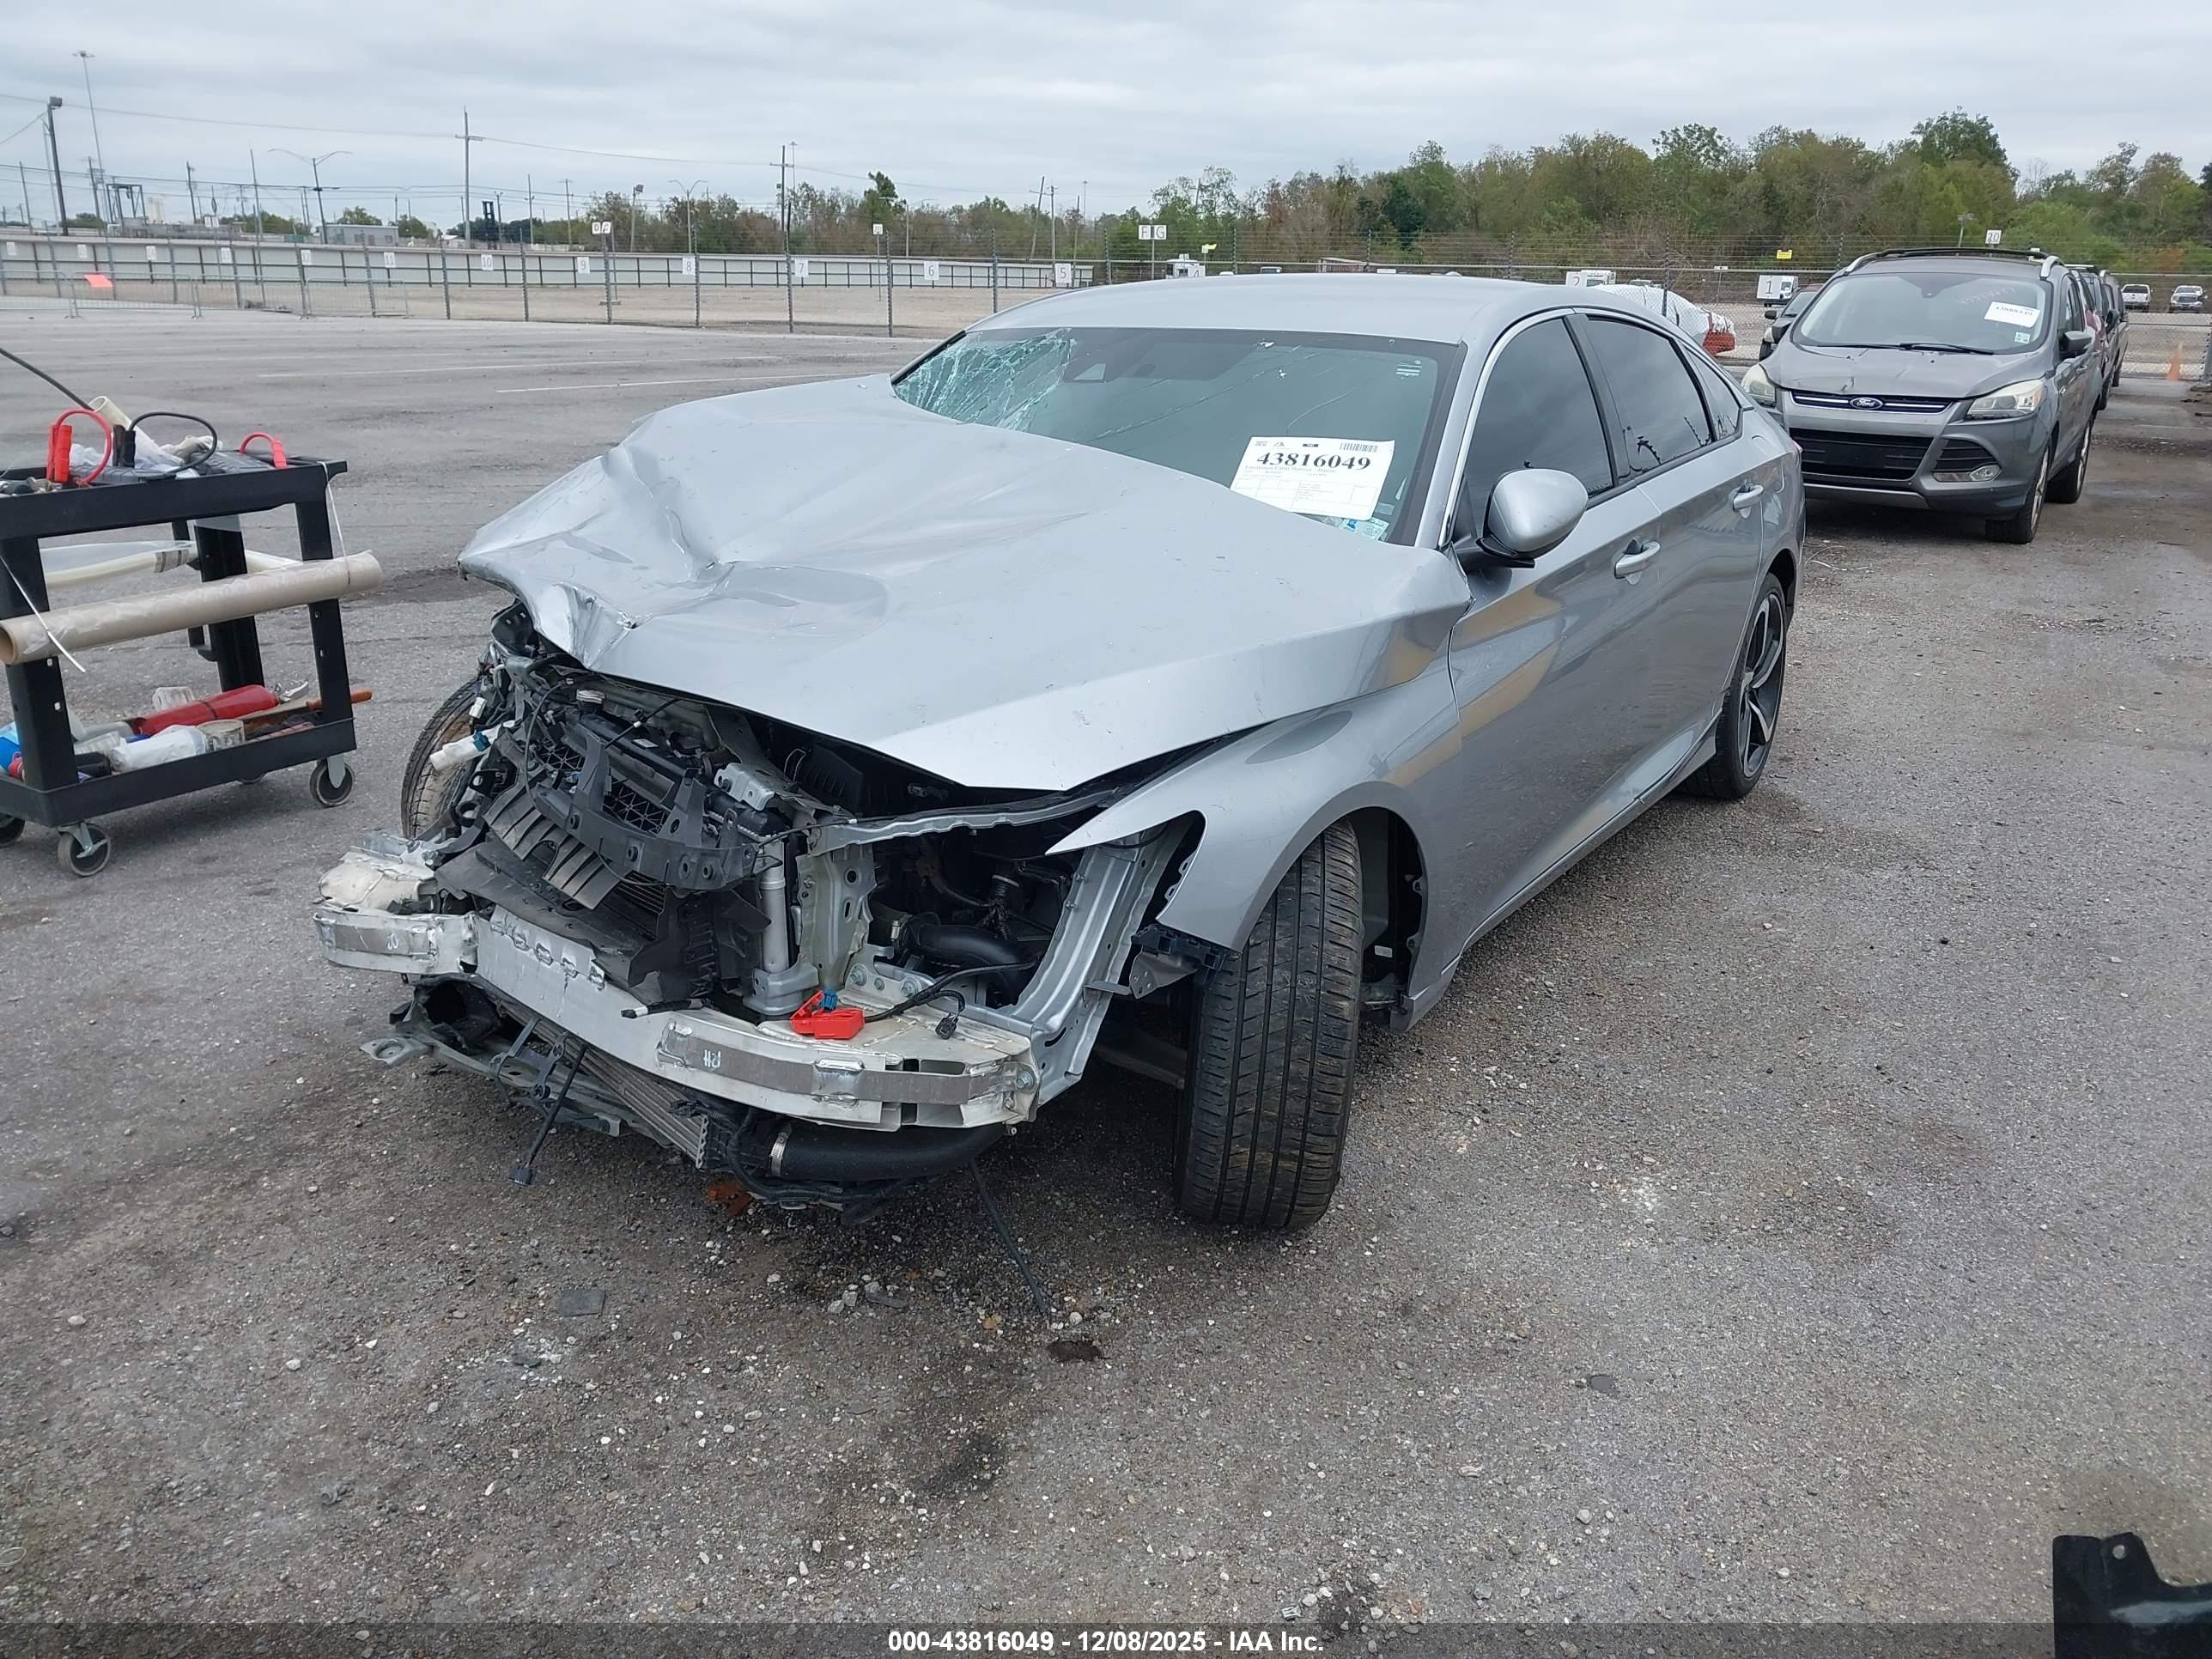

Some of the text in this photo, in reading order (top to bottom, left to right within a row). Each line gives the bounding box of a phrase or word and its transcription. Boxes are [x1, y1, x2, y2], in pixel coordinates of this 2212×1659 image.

[1141, 226, 1165, 238] F G
[483, 258, 492, 268] 10
[928, 264, 935, 276] 6
[1060, 267, 1066, 279] 5
[1256, 452, 1371, 471] 43816049
